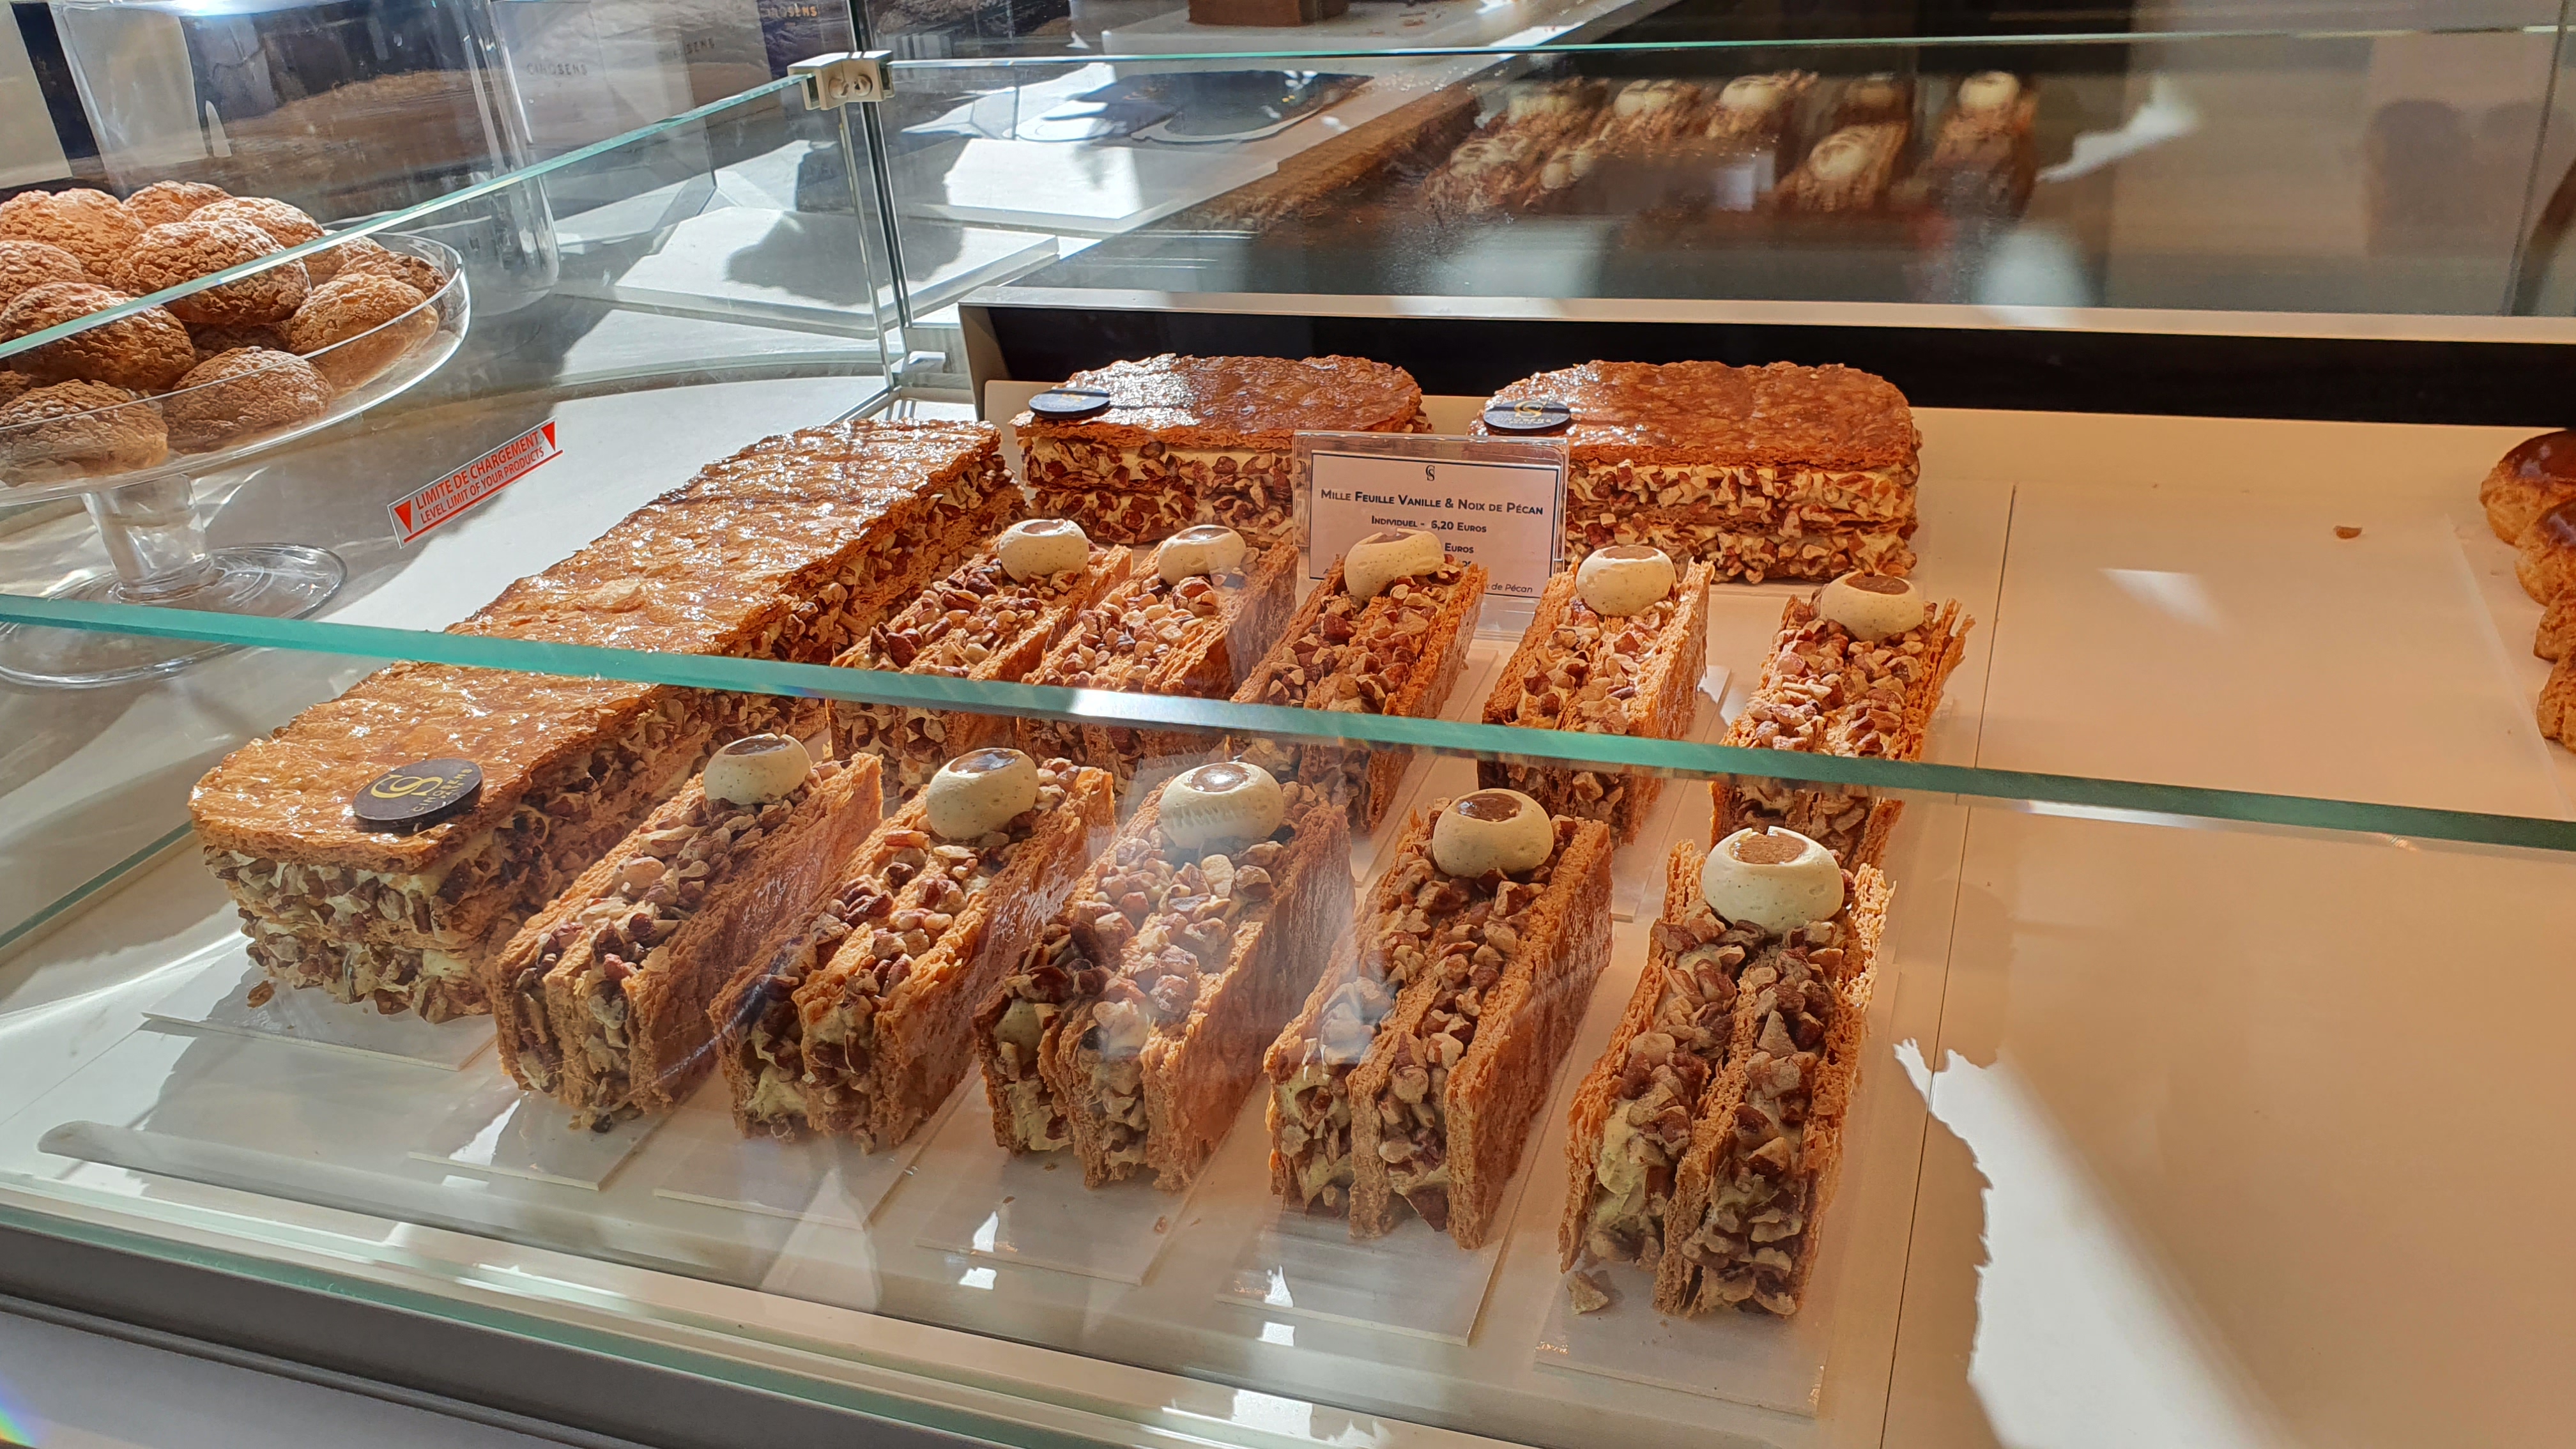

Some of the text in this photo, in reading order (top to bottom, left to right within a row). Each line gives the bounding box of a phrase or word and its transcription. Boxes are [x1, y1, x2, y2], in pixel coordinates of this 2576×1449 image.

[415, 431, 540, 510] LIMITE DE CHARGEMENT
[420, 447, 544, 524] LEVEL LIMIT OF YOUR PRODUCTS
[1445, 498, 1453, 509] &
[1489, 503, 1503, 512] DE
[1431, 520, 1454, 531] 6,20
[1491, 583, 1503, 591] de
[1505, 584, 1533, 594] Pécan
